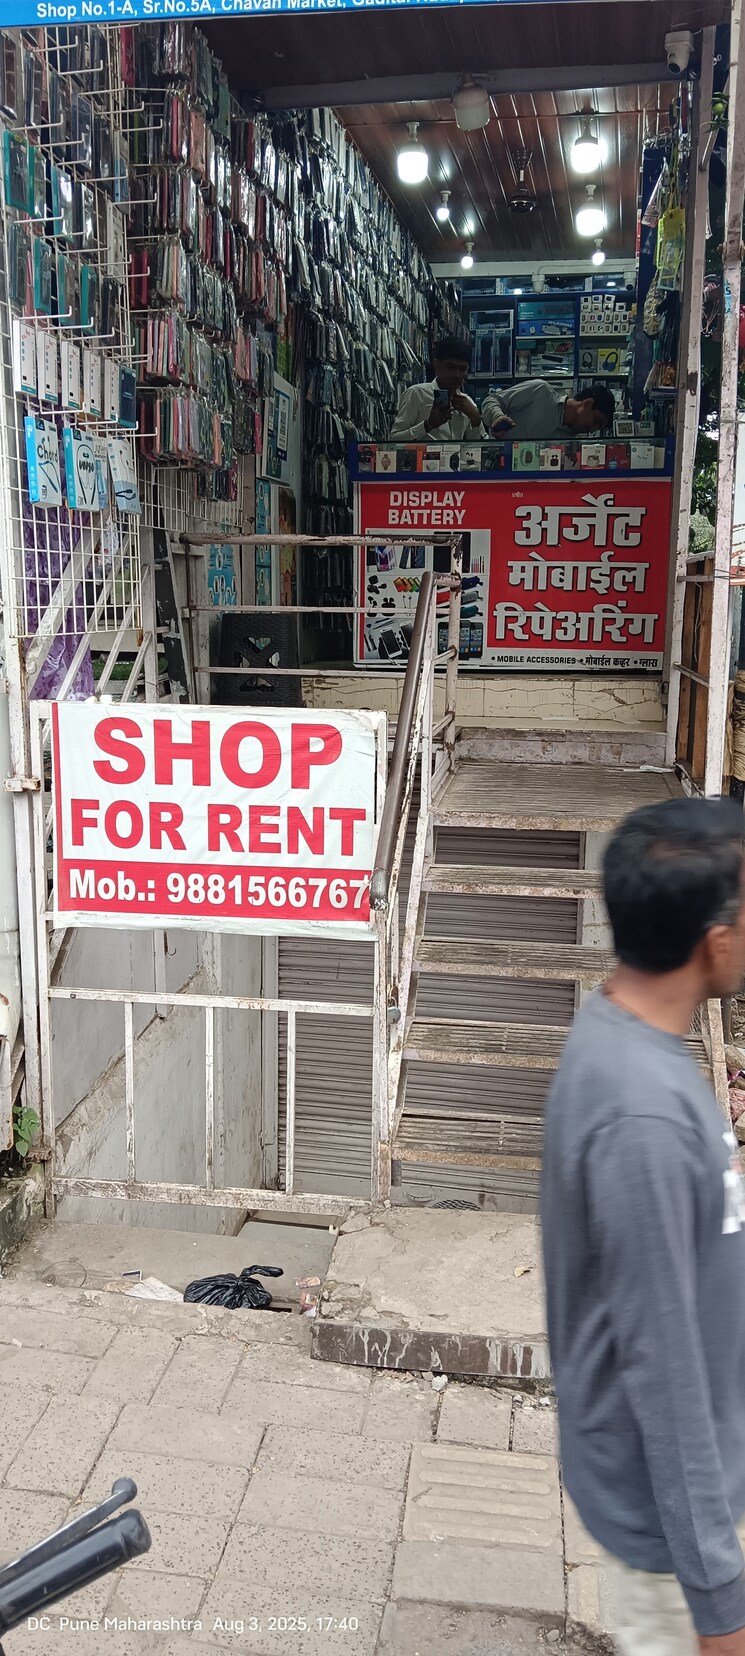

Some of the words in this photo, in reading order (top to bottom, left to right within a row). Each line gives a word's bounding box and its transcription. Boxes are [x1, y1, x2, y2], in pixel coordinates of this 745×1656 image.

[36, 3, 77, 20] Shop
[81, 0, 138, 17] No.1-A,
[142, 0, 216, 14] Sr.No.5A,
[221, 0, 282, 11] Chavan
[388, 509, 466, 525] BATTERY
[389, 490, 466, 507] DISPLAY
[514, 493, 647, 548] अर्जेंट
[507, 551, 650, 595] मोबाईल
[493, 600, 660, 643] रिपेअरिंग
[496, 655, 525, 664] MOBILE
[526, 655, 576, 665] ACCESSORIES
[584, 654, 611, 667] मोबाईल
[93, 716, 343, 790] SHOP
[71, 798, 187, 851] FOR
[207, 803, 367, 857] RENT
[69, 868, 156, 902] Mob.:
[166, 872, 370, 909] 9881566767
